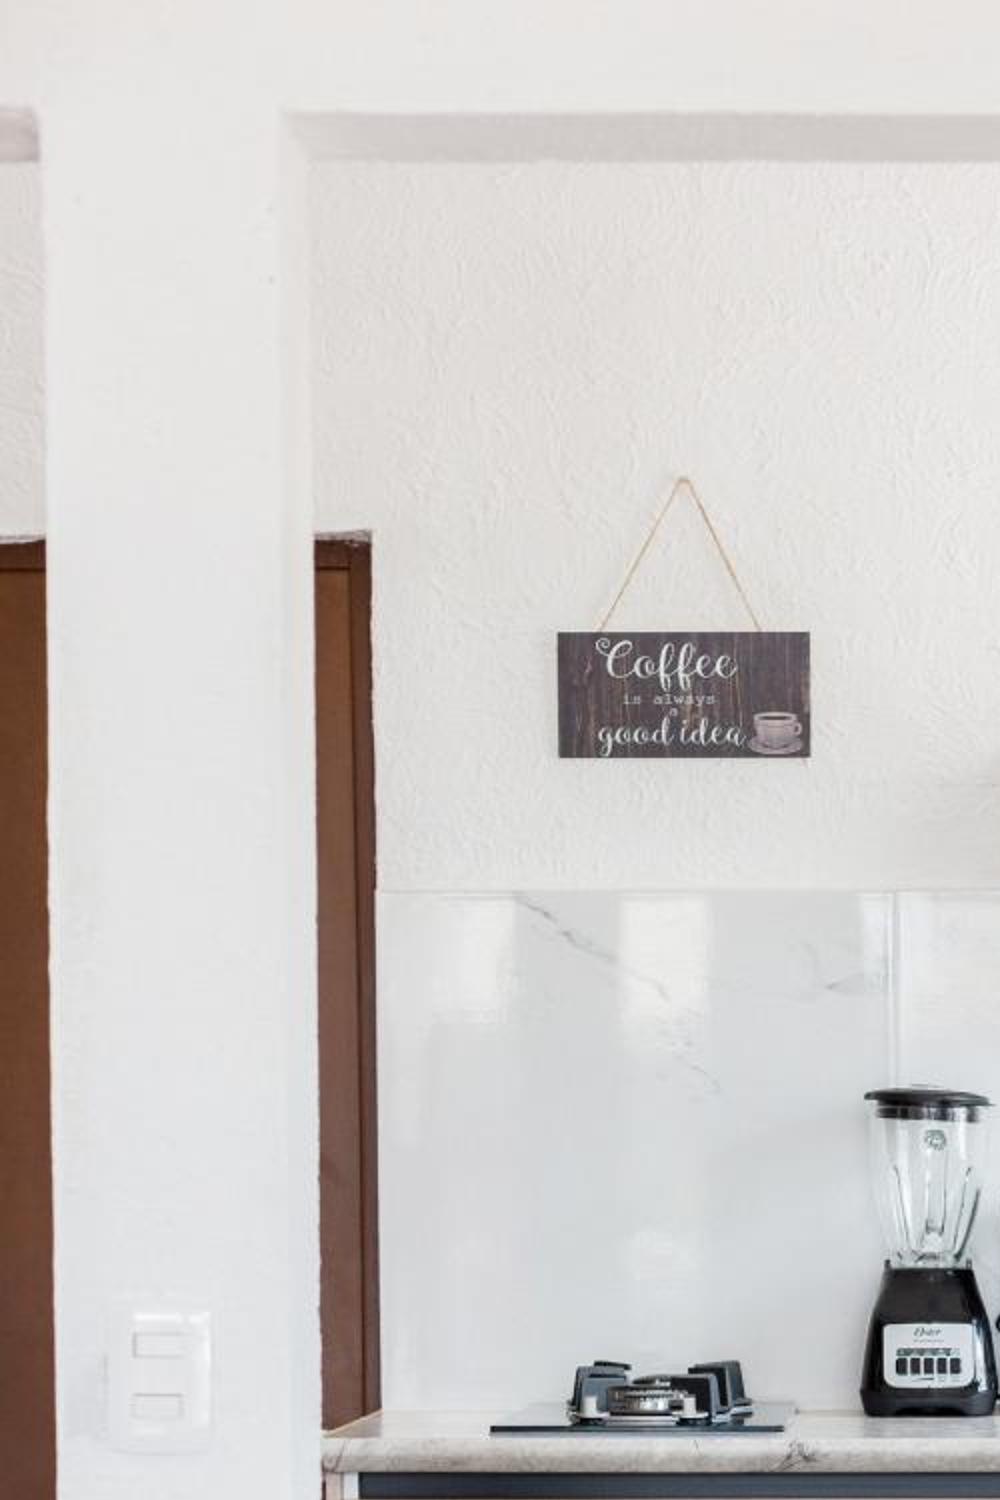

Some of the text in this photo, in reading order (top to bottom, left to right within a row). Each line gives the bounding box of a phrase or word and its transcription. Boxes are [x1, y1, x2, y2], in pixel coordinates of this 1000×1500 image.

[595, 637, 738, 692] Coffee
[623, 694, 717, 705] is always
[598, 716, 747, 756] good idea
